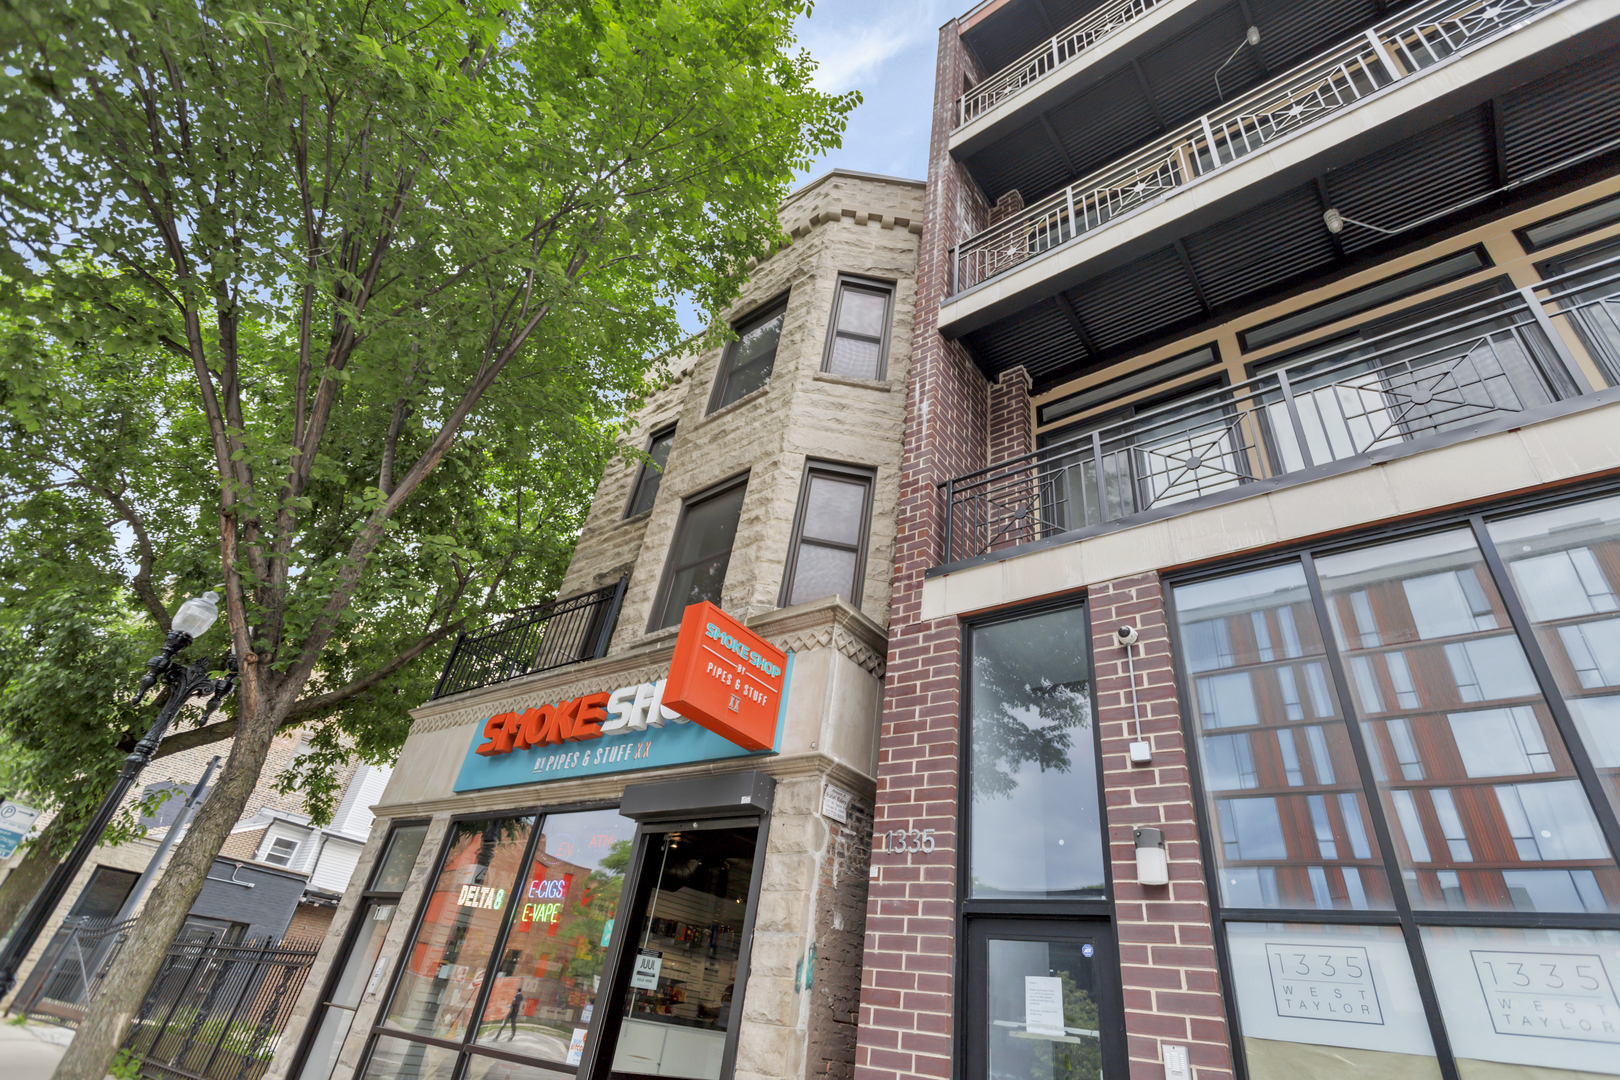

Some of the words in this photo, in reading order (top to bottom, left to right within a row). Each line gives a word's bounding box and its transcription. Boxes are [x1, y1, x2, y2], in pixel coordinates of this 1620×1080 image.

[705, 623, 750, 661] SMOKE
[749, 651, 781, 678] SHOP
[737, 664, 746, 675] BY
[707, 662, 732, 686] PIPES
[743, 684, 768, 706] STUFF
[475, 691, 611, 757] SMOKE
[600, 678, 692, 736] SH
[533, 757, 546, 773] BY
[546, 752, 580, 771] PIPES
[594, 743, 633, 765] STUFF
[588, 834, 614, 848] ATM
[885, 828, 936, 855] 1335
[457, 884, 495, 909] DELTA
[529, 880, 566, 899] E-CIGS
[522, 903, 561, 923] E-VAPE
[1274, 953, 1363, 978] 1335
[1482, 961, 1599, 991] 1335
[1282, 985, 1366, 1000] WEST
[1285, 999, 1370, 1015] TAYLOR
[1497, 998, 1605, 1016] WEST
[1502, 1014, 1615, 1033] TAYLOR
[570, 1043, 583, 1052] BITCO
